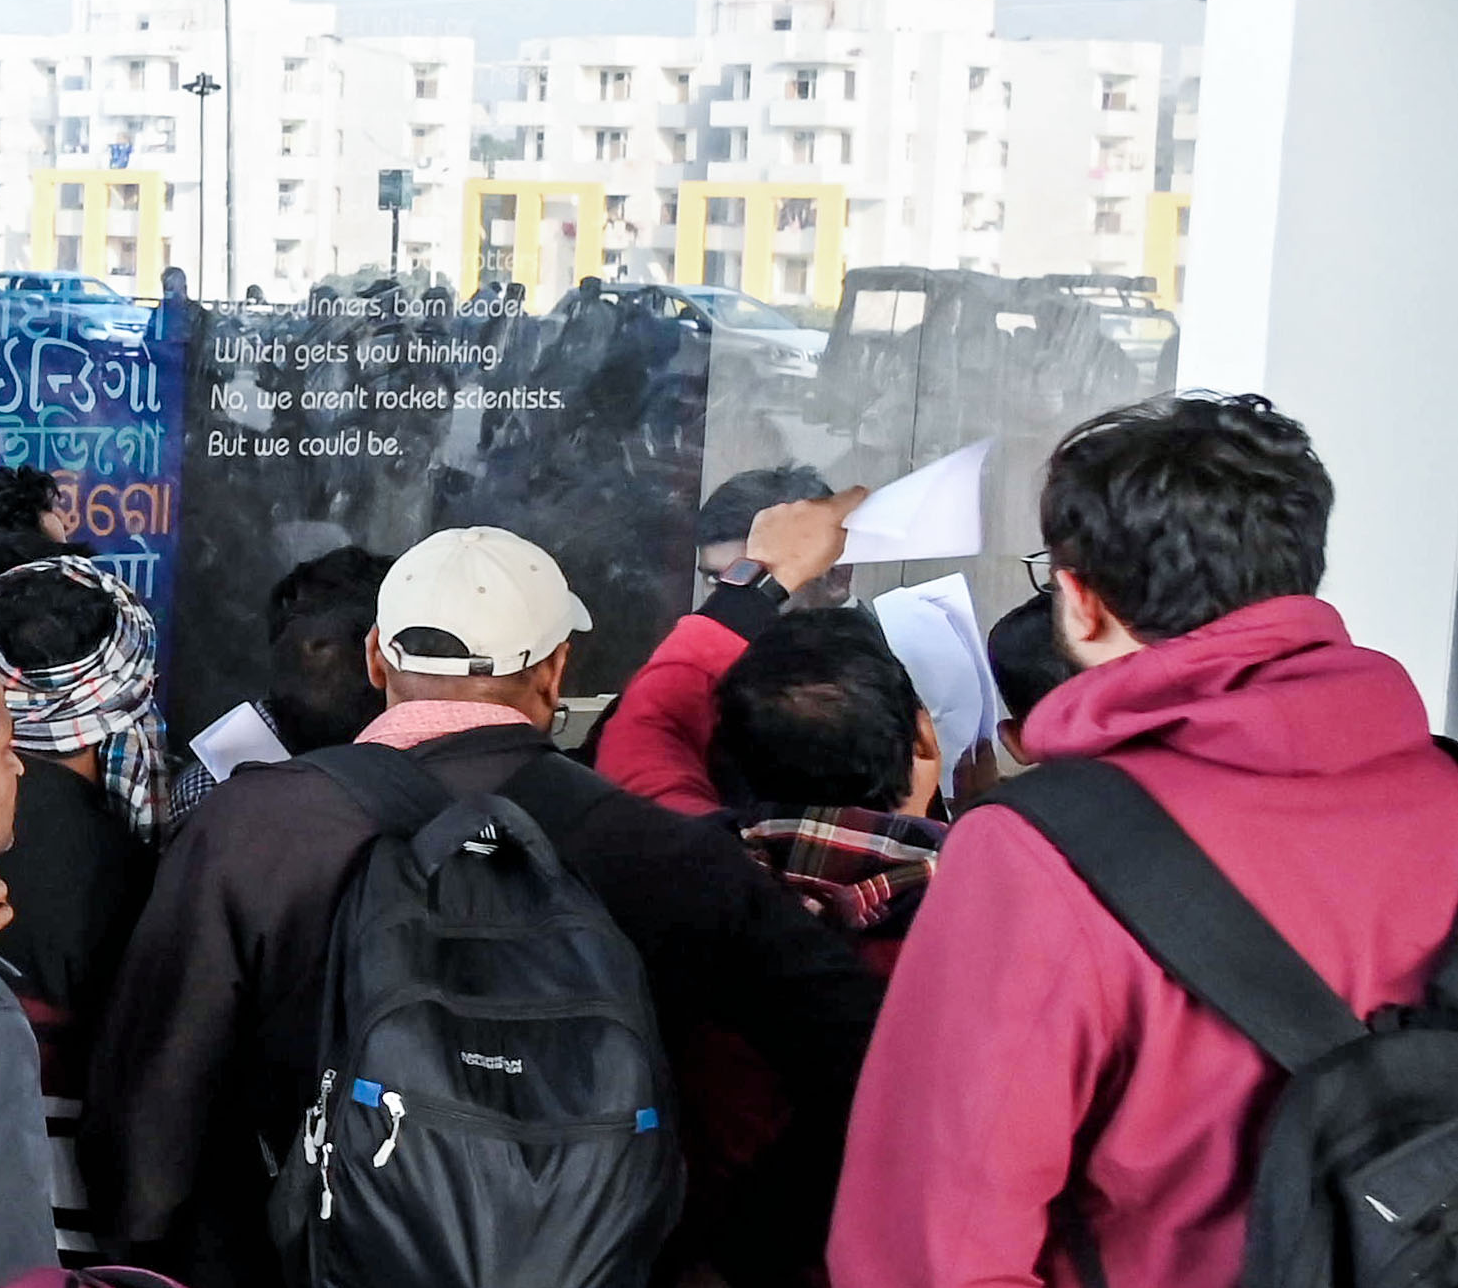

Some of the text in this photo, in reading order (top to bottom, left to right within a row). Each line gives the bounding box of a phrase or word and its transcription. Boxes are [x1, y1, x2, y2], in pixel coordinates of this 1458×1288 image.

[394, 293, 446, 318] born
[214, 335, 503, 371] Which gets you thinking.
[210, 384, 566, 412] No, we aren't rocket scientists.
[208, 430, 404, 457] But we could be.
